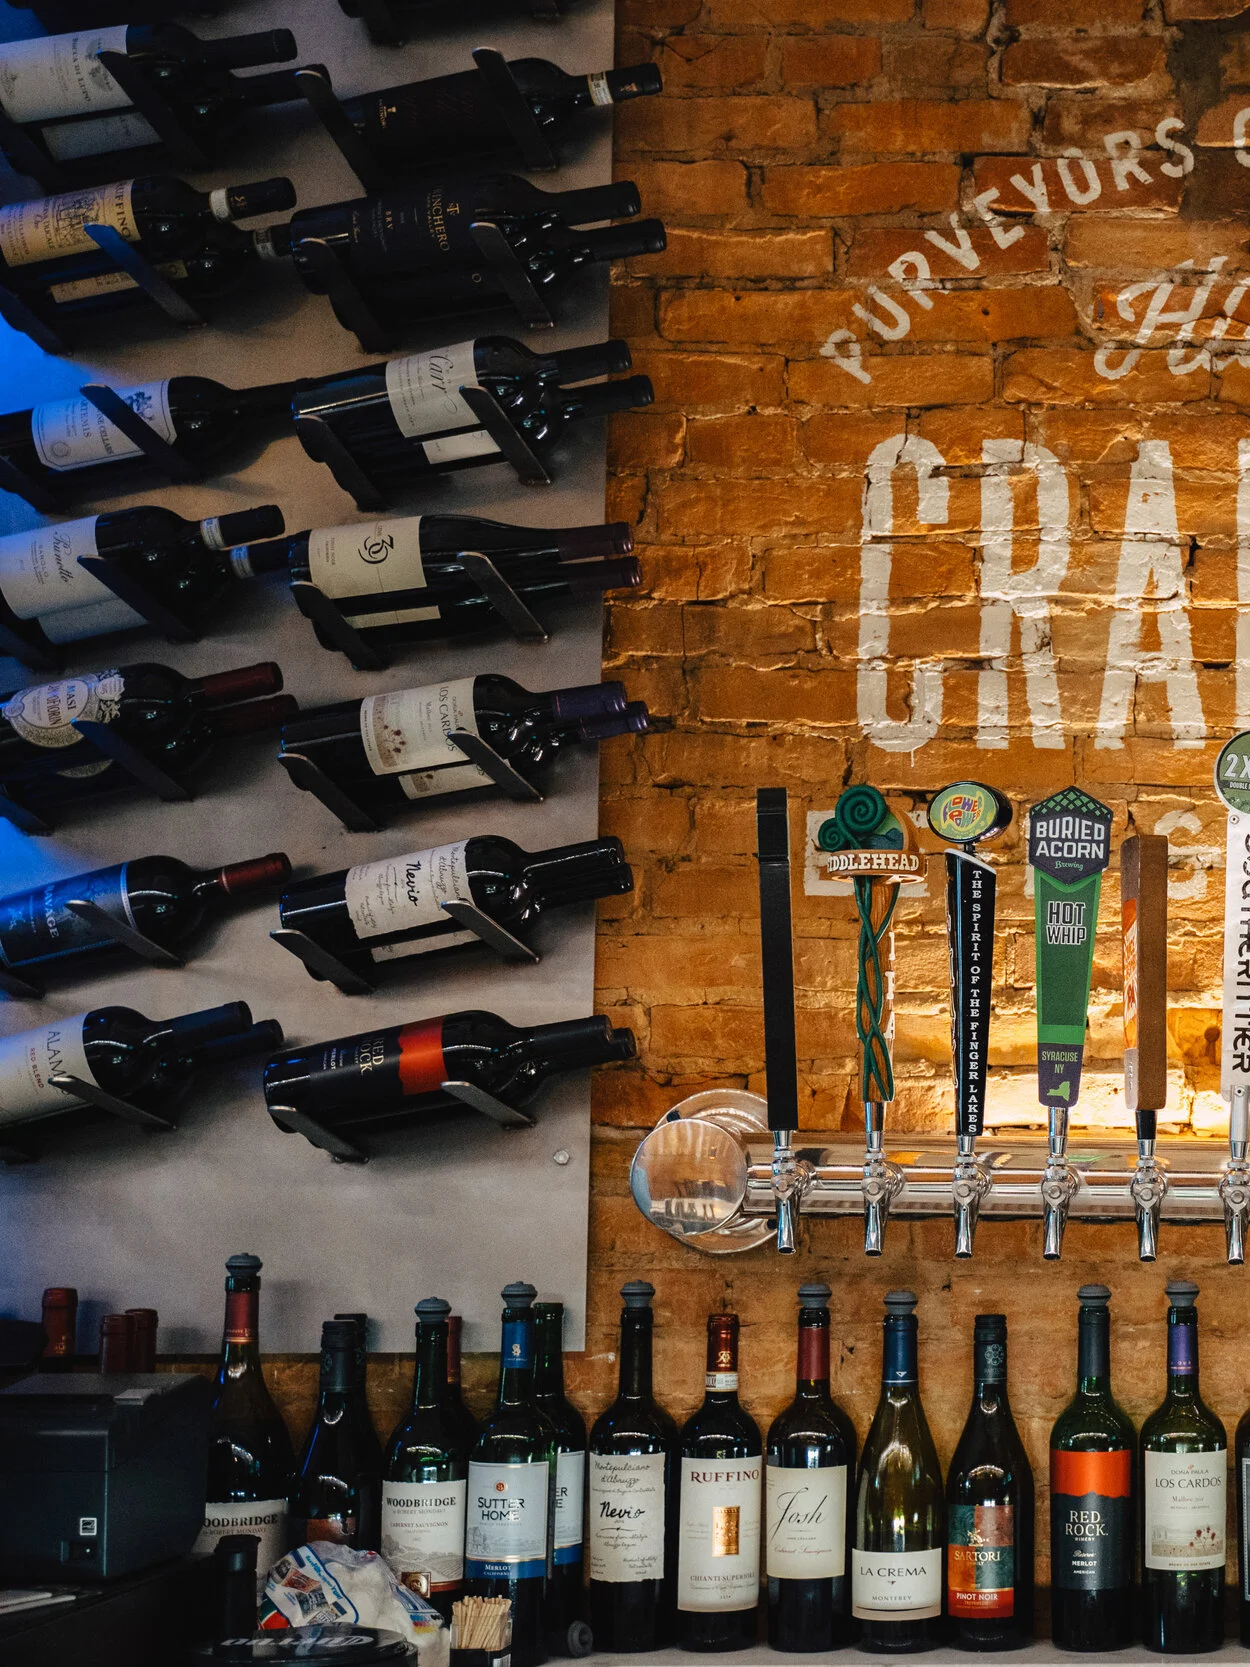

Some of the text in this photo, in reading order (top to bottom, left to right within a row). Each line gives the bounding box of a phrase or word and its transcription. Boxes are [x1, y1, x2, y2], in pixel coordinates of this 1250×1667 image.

[819, 117, 1194, 385] PURVEYORS
[64, 685, 79, 710] MASI
[438, 686, 451, 701] LOS
[1229, 781, 1247, 790] DOUBLE
[1035, 816, 1105, 841] BURIED
[1035, 840, 1104, 860] ACORN
[827, 853, 919, 872] IDDLEHEAD
[1055, 860, 1084, 871] Brewing
[400, 860, 431, 908] Nevio
[1047, 901, 1086, 927] HOT
[1046, 924, 1086, 945] WHIP
[967, 870, 982, 1133] THE SPIRIT OF THE FINGER LAKES
[1041, 1050, 1078, 1063] SYRACUSE
[28, 1048, 45, 1089] RED BLEND
[1054, 1063, 1064, 1074] NY
[690, 1469, 760, 1484] RUFFINO
[1155, 1476, 1222, 1489] LOS CARDOS
[386, 1496, 457, 1508] WOODBRIDGE
[477, 1496, 525, 1509] SUTTER
[481, 1509, 521, 1521] HOME
[599, 1500, 646, 1519] Nevio
[768, 1486, 828, 1546] Josh
[1069, 1510, 1101, 1523] RED
[203, 1514, 279, 1528] OODBRIDGE
[954, 1550, 1001, 1562] SARTORI
[689, 1574, 721, 1582] CHIANTI
[860, 1566, 927, 1577] LA CREMA
[956, 1592, 998, 1601] PINOT NOIR
